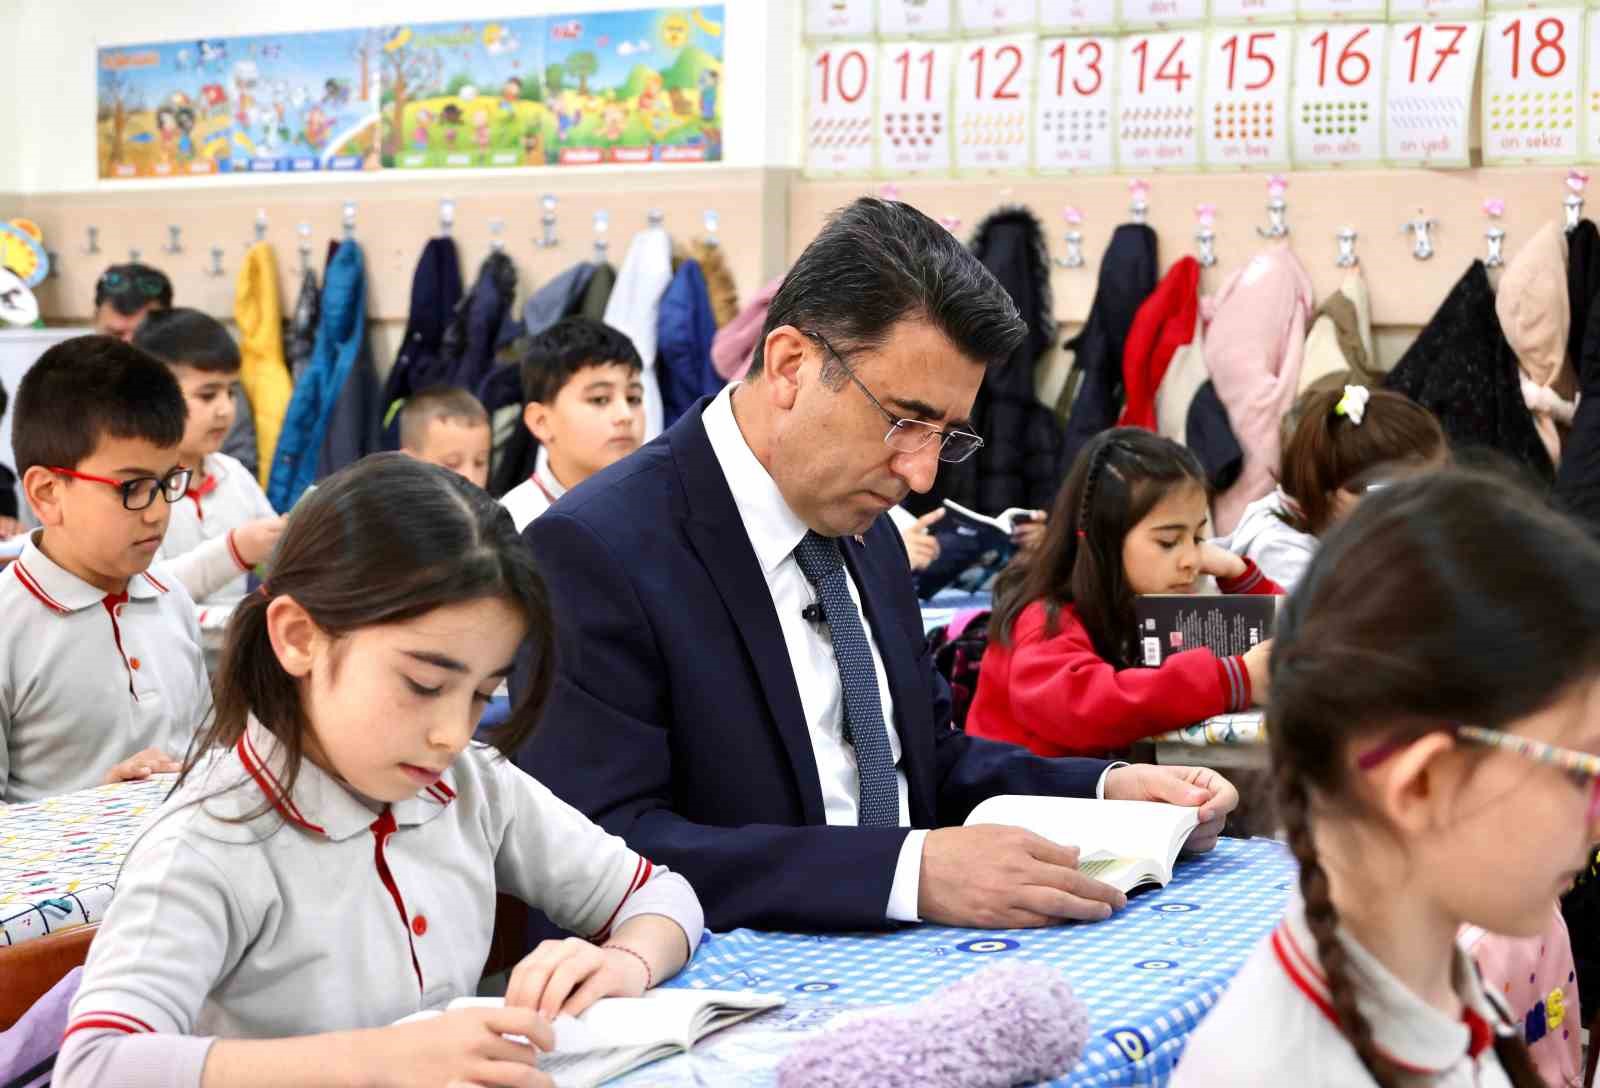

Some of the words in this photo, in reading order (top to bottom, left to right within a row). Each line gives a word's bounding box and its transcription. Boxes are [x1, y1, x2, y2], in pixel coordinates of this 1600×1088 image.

[815, 50, 868, 103] 10
[895, 47, 936, 101] 11
[969, 45, 1024, 100] 12
[1049, 41, 1103, 97] 13
[1131, 37, 1192, 95] 14
[1220, 32, 1276, 91] 15
[1311, 28, 1371, 88] 16
[1404, 25, 1467, 84] 17
[1502, 17, 1567, 79] 18
